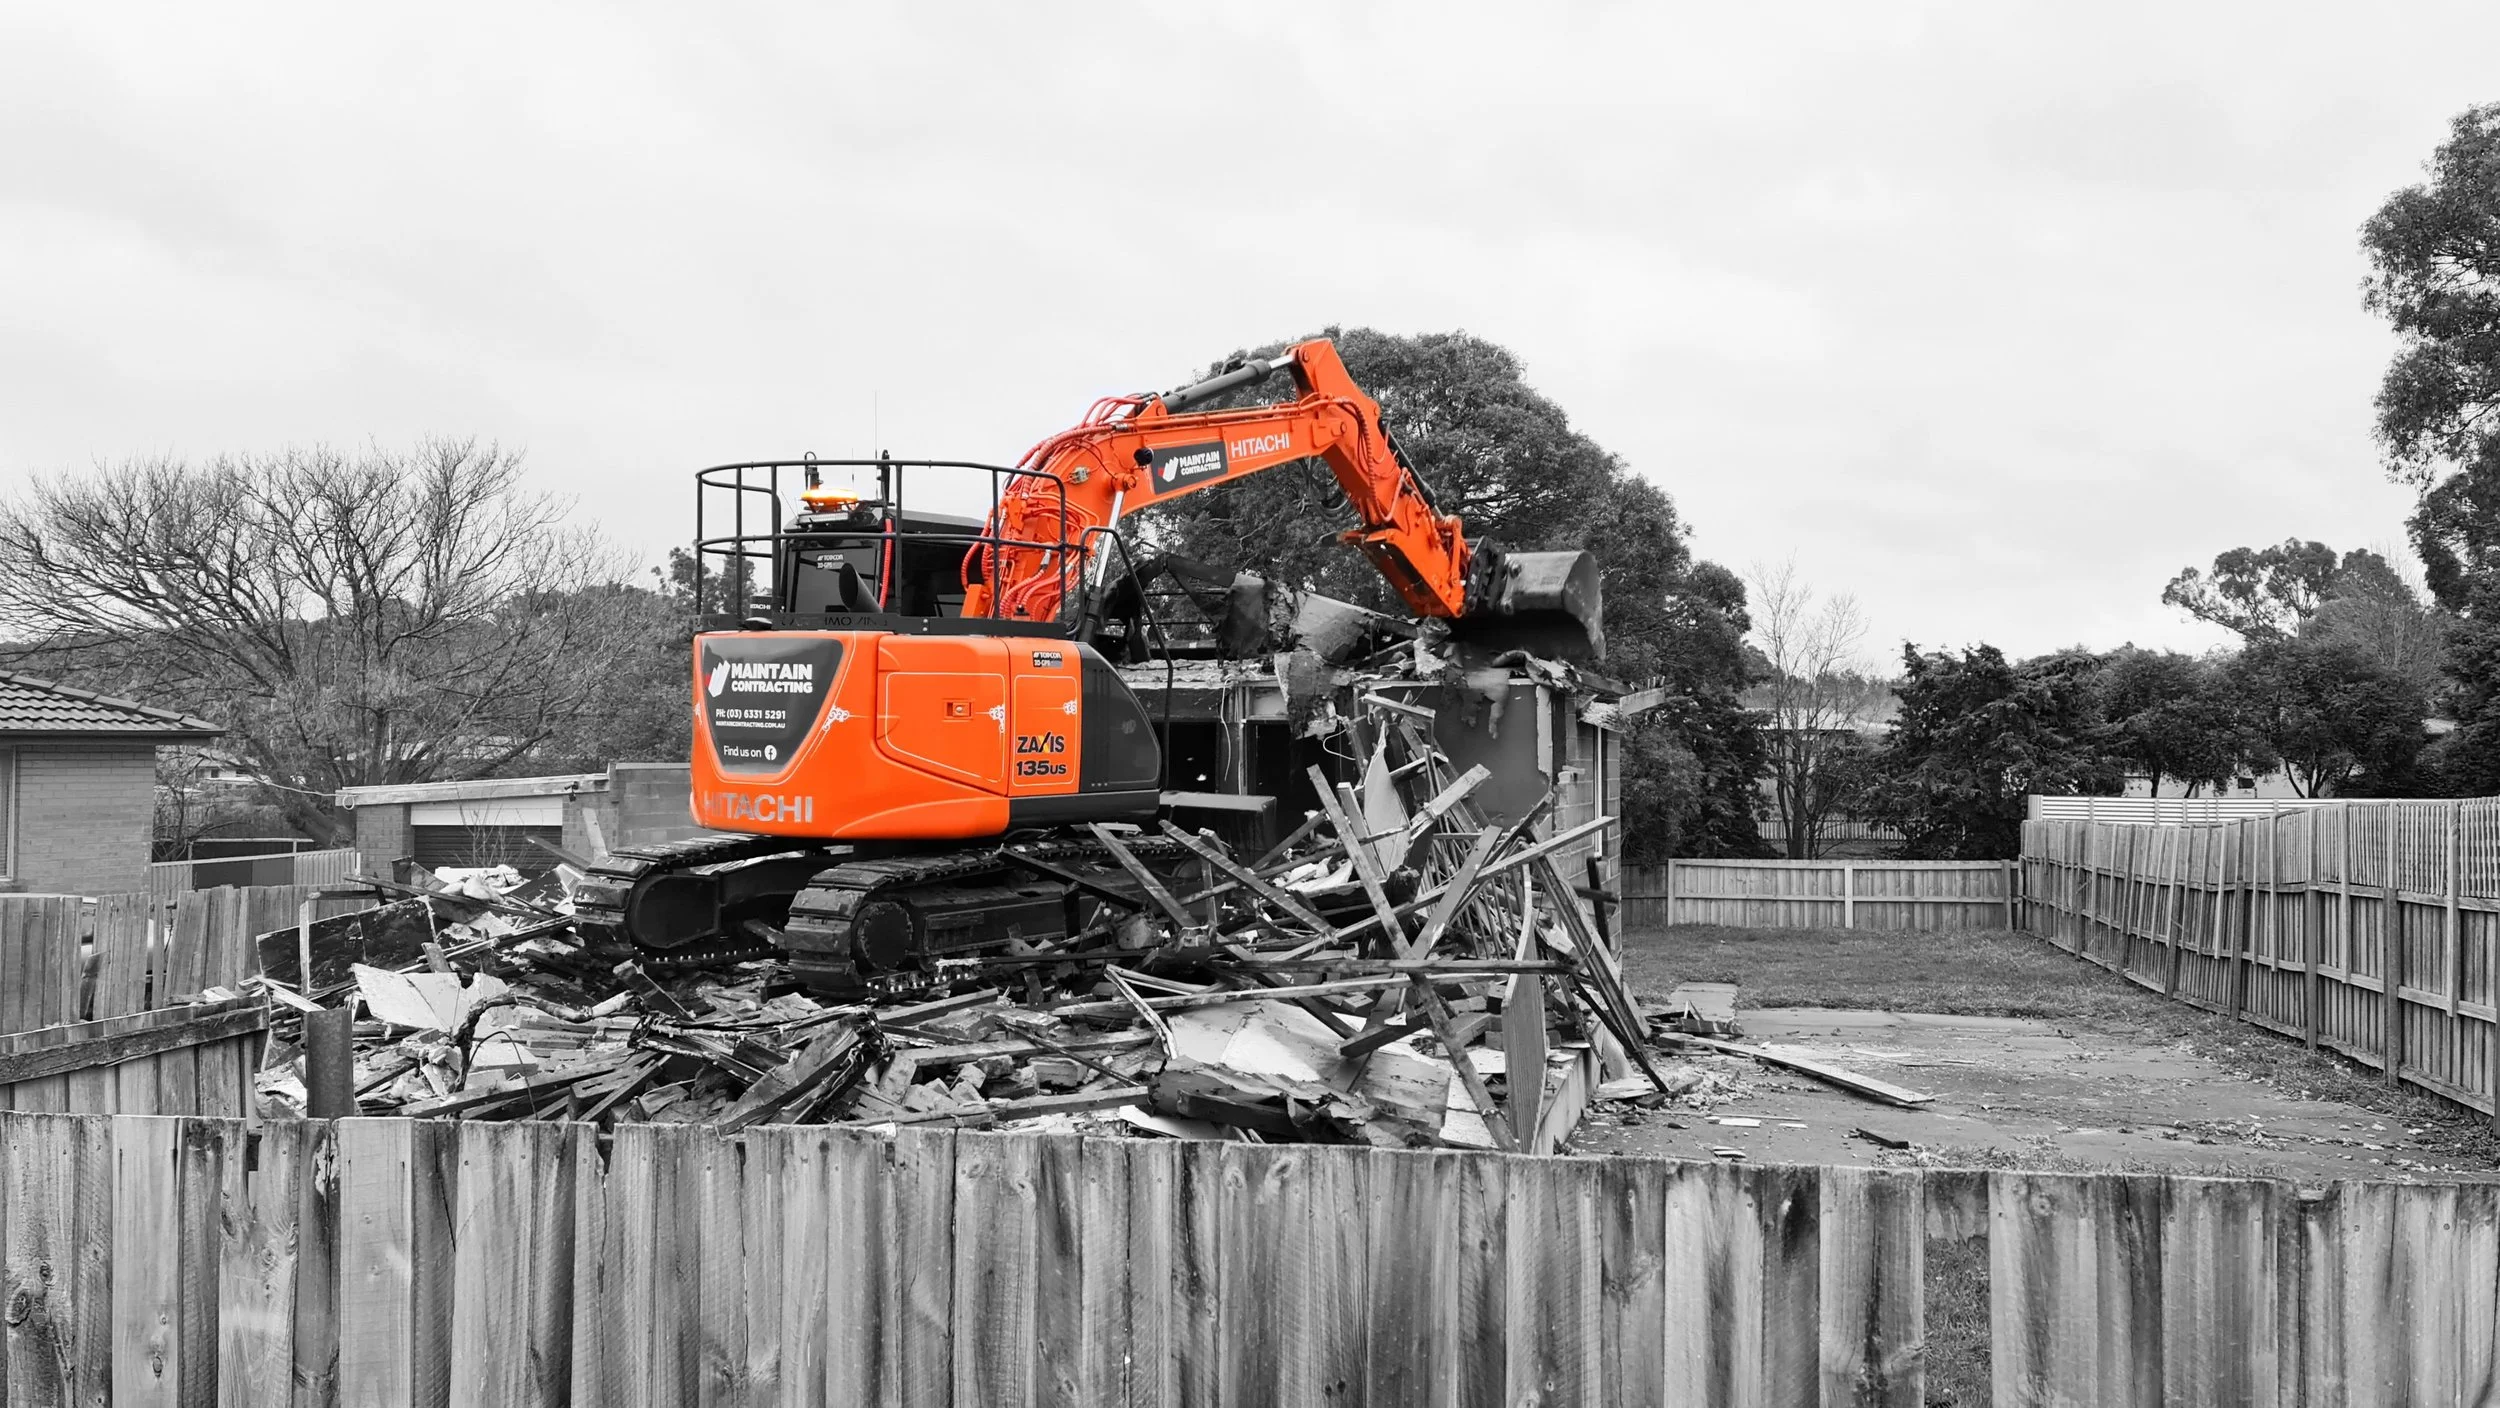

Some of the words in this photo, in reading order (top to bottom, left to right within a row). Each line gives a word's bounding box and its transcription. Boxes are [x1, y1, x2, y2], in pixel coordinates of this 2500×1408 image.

[1231, 432, 1290, 458] HITACHI
[1179, 450, 1220, 467] MAINTAIN
[1181, 461, 1221, 476] CONTRACTING
[731, 663, 812, 680] MAINTAIN
[731, 681, 813, 693] CONTRACTING
[715, 708, 726, 718] PH:
[726, 708, 742, 720] (03)
[743, 709, 763, 719] 6331
[764, 710, 786, 720] 5291
[1017, 731, 1065, 754] ZAXIS
[723, 745, 739, 757] Find
[740, 750, 750, 758] us
[750, 750, 762, 758] on
[703, 790, 813, 823] HITACHI
